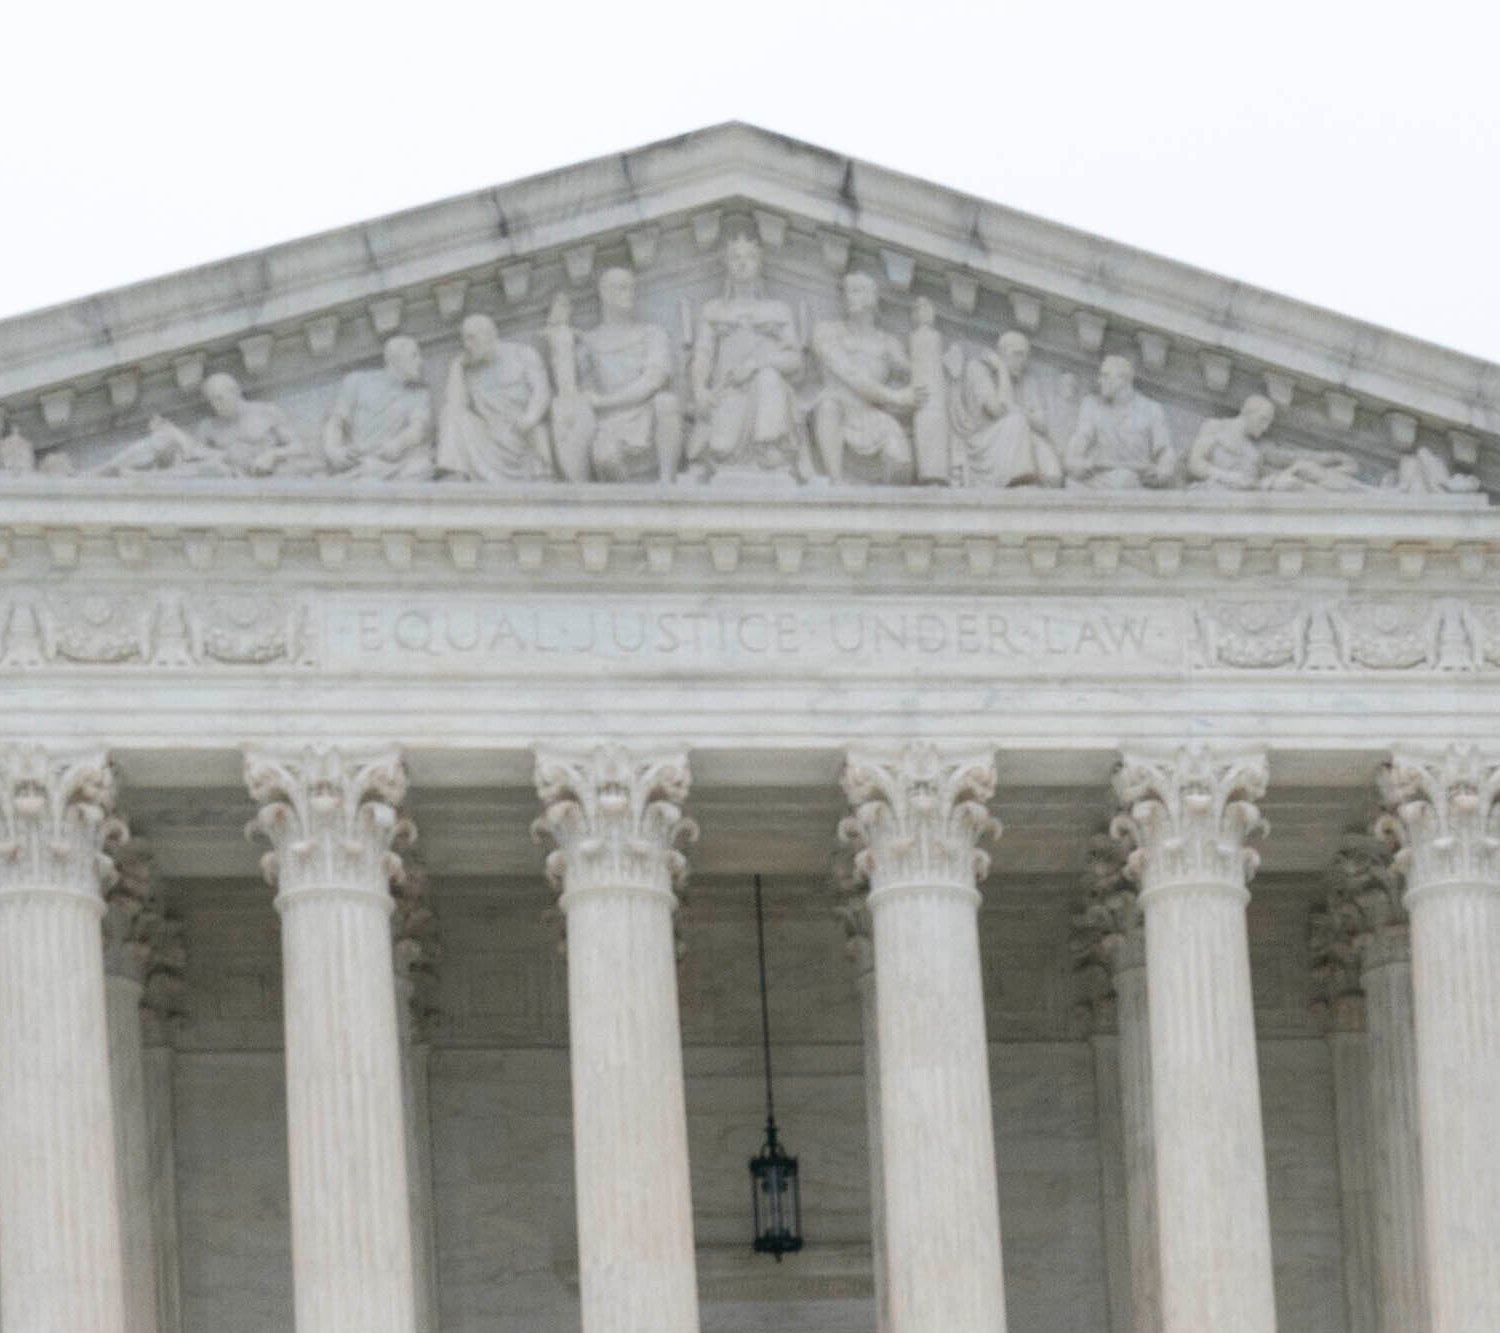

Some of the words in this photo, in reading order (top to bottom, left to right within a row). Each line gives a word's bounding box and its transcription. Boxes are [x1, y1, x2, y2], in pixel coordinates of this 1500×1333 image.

[358, 610, 559, 654] EQUAL
[582, 610, 798, 655] JUSTICE
[831, 610, 1015, 655] UNDER
[1042, 612, 1148, 656] LAW
